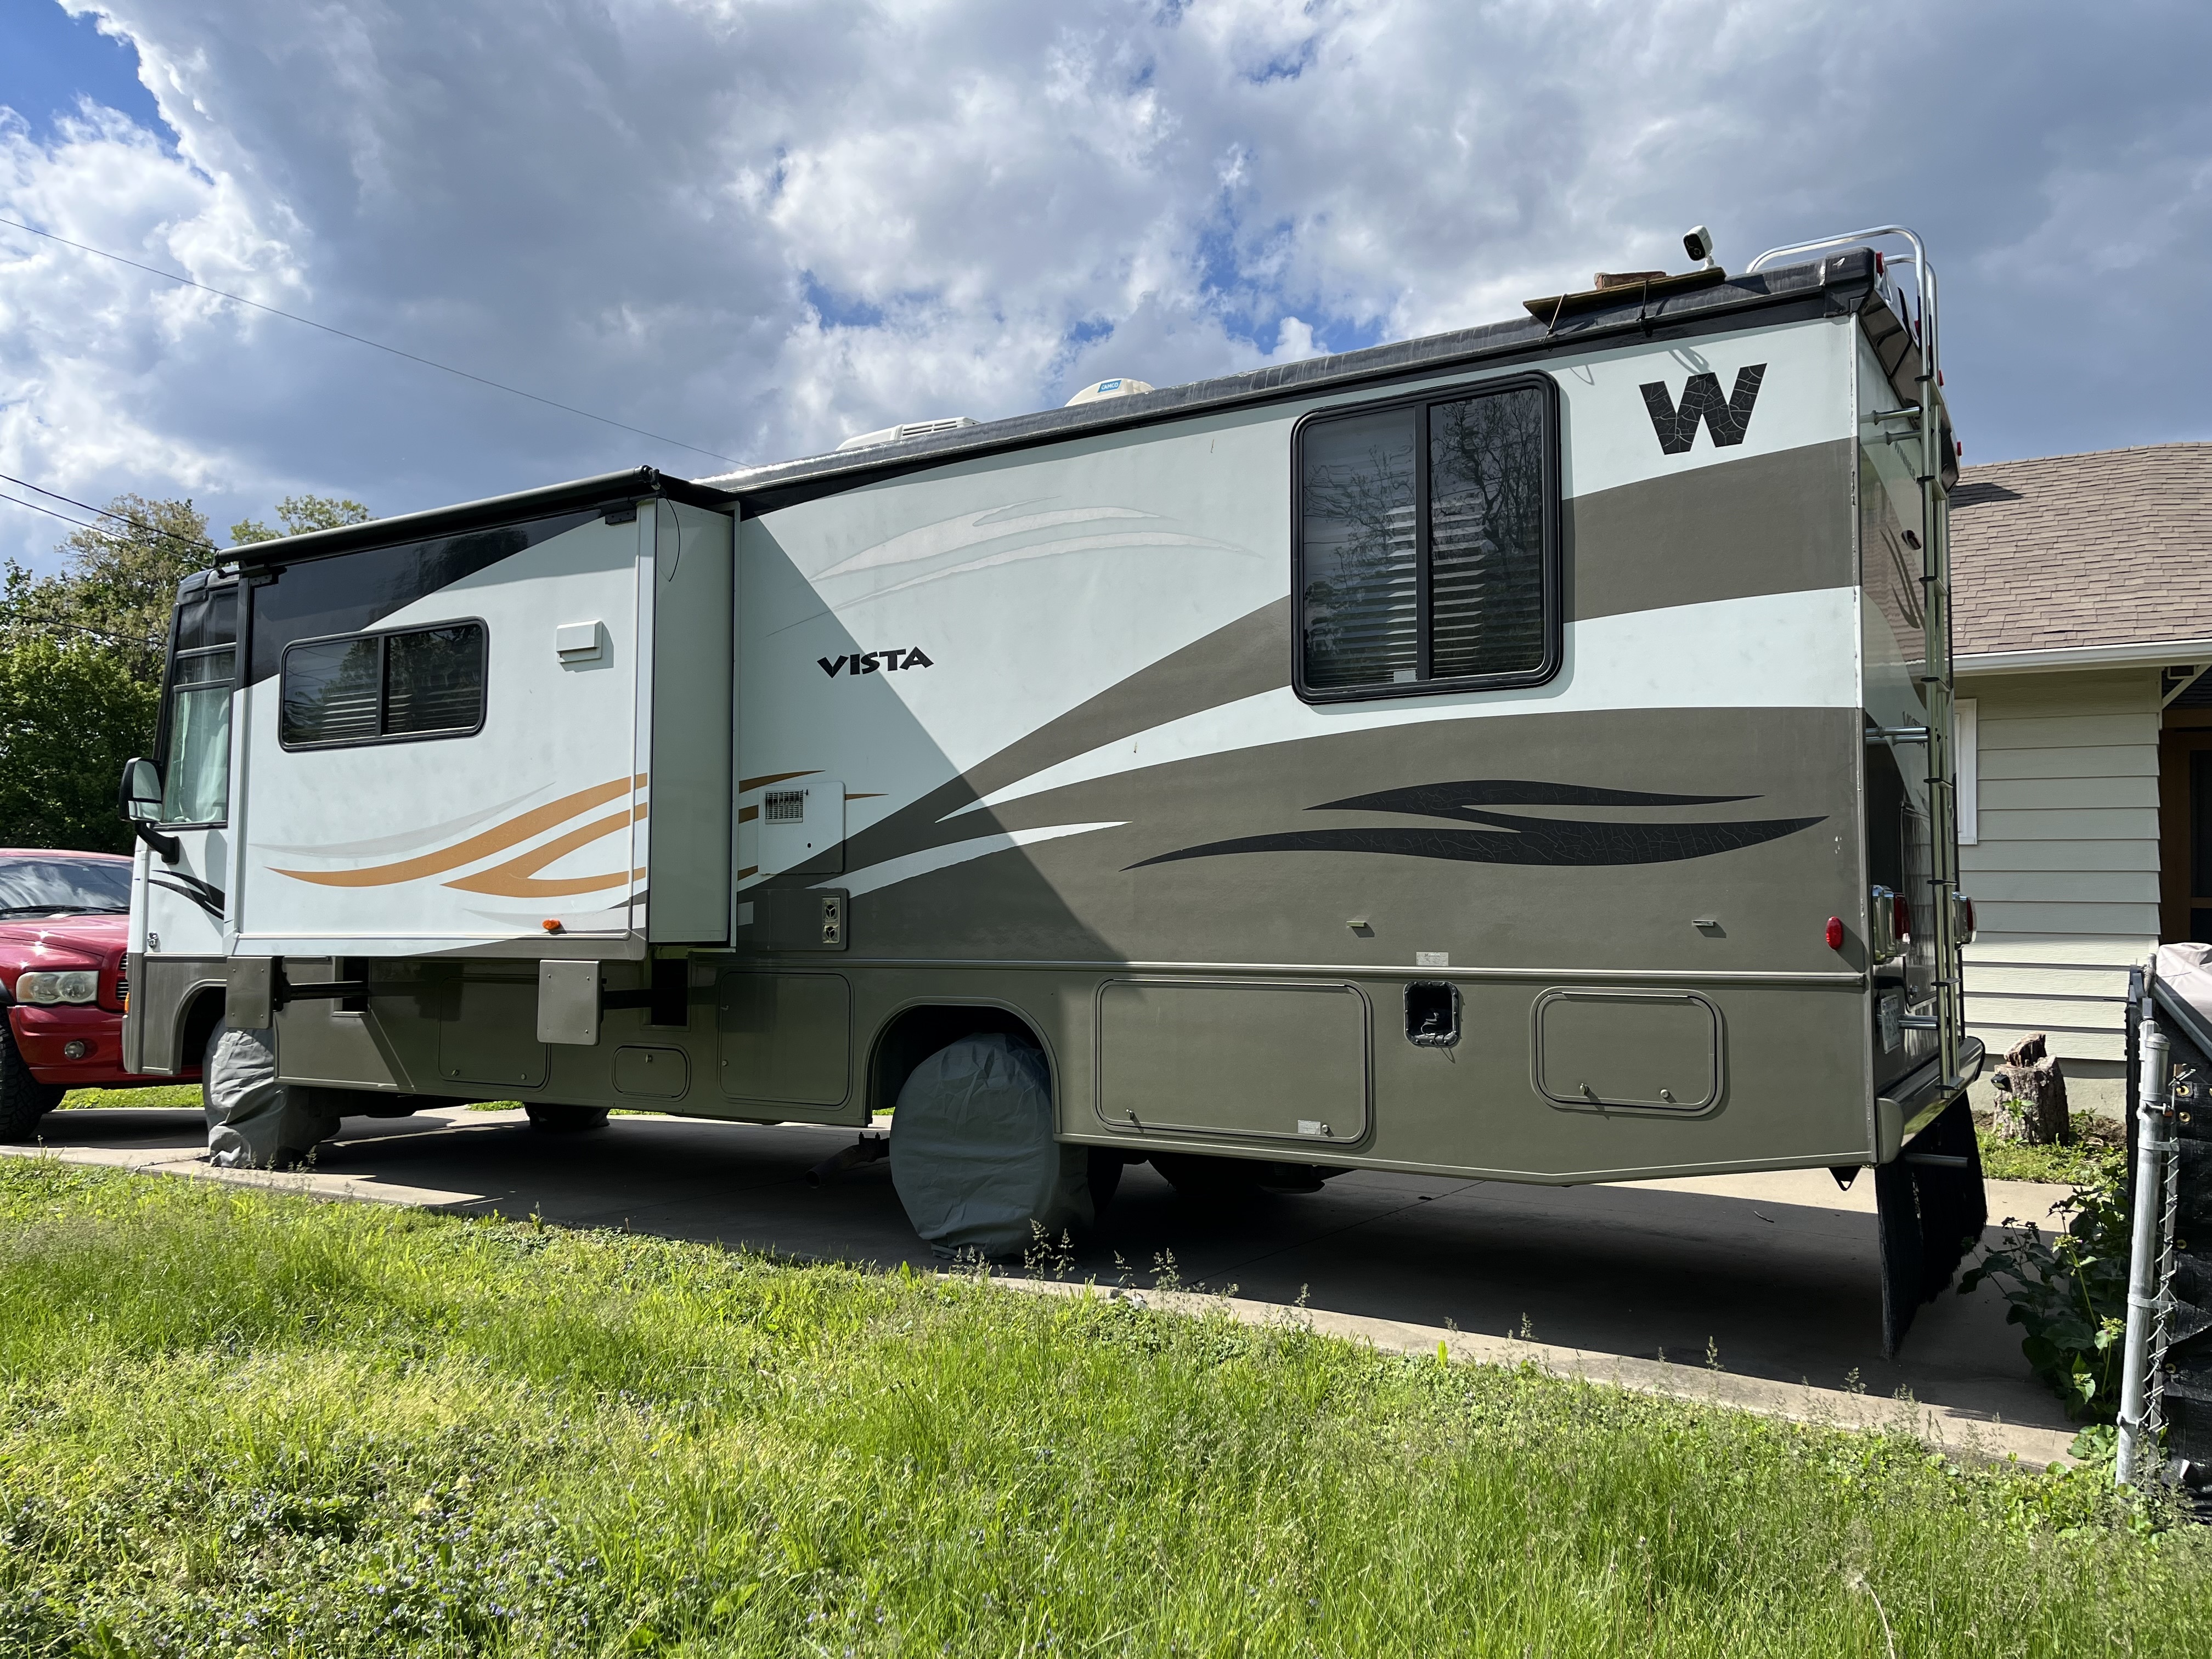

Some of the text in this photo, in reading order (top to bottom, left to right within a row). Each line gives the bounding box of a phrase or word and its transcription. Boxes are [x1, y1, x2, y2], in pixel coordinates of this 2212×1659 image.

[1101, 382, 1119, 390] CAMCO
[1639, 363, 1768, 455] W
[817, 646, 934, 678] VISTA
